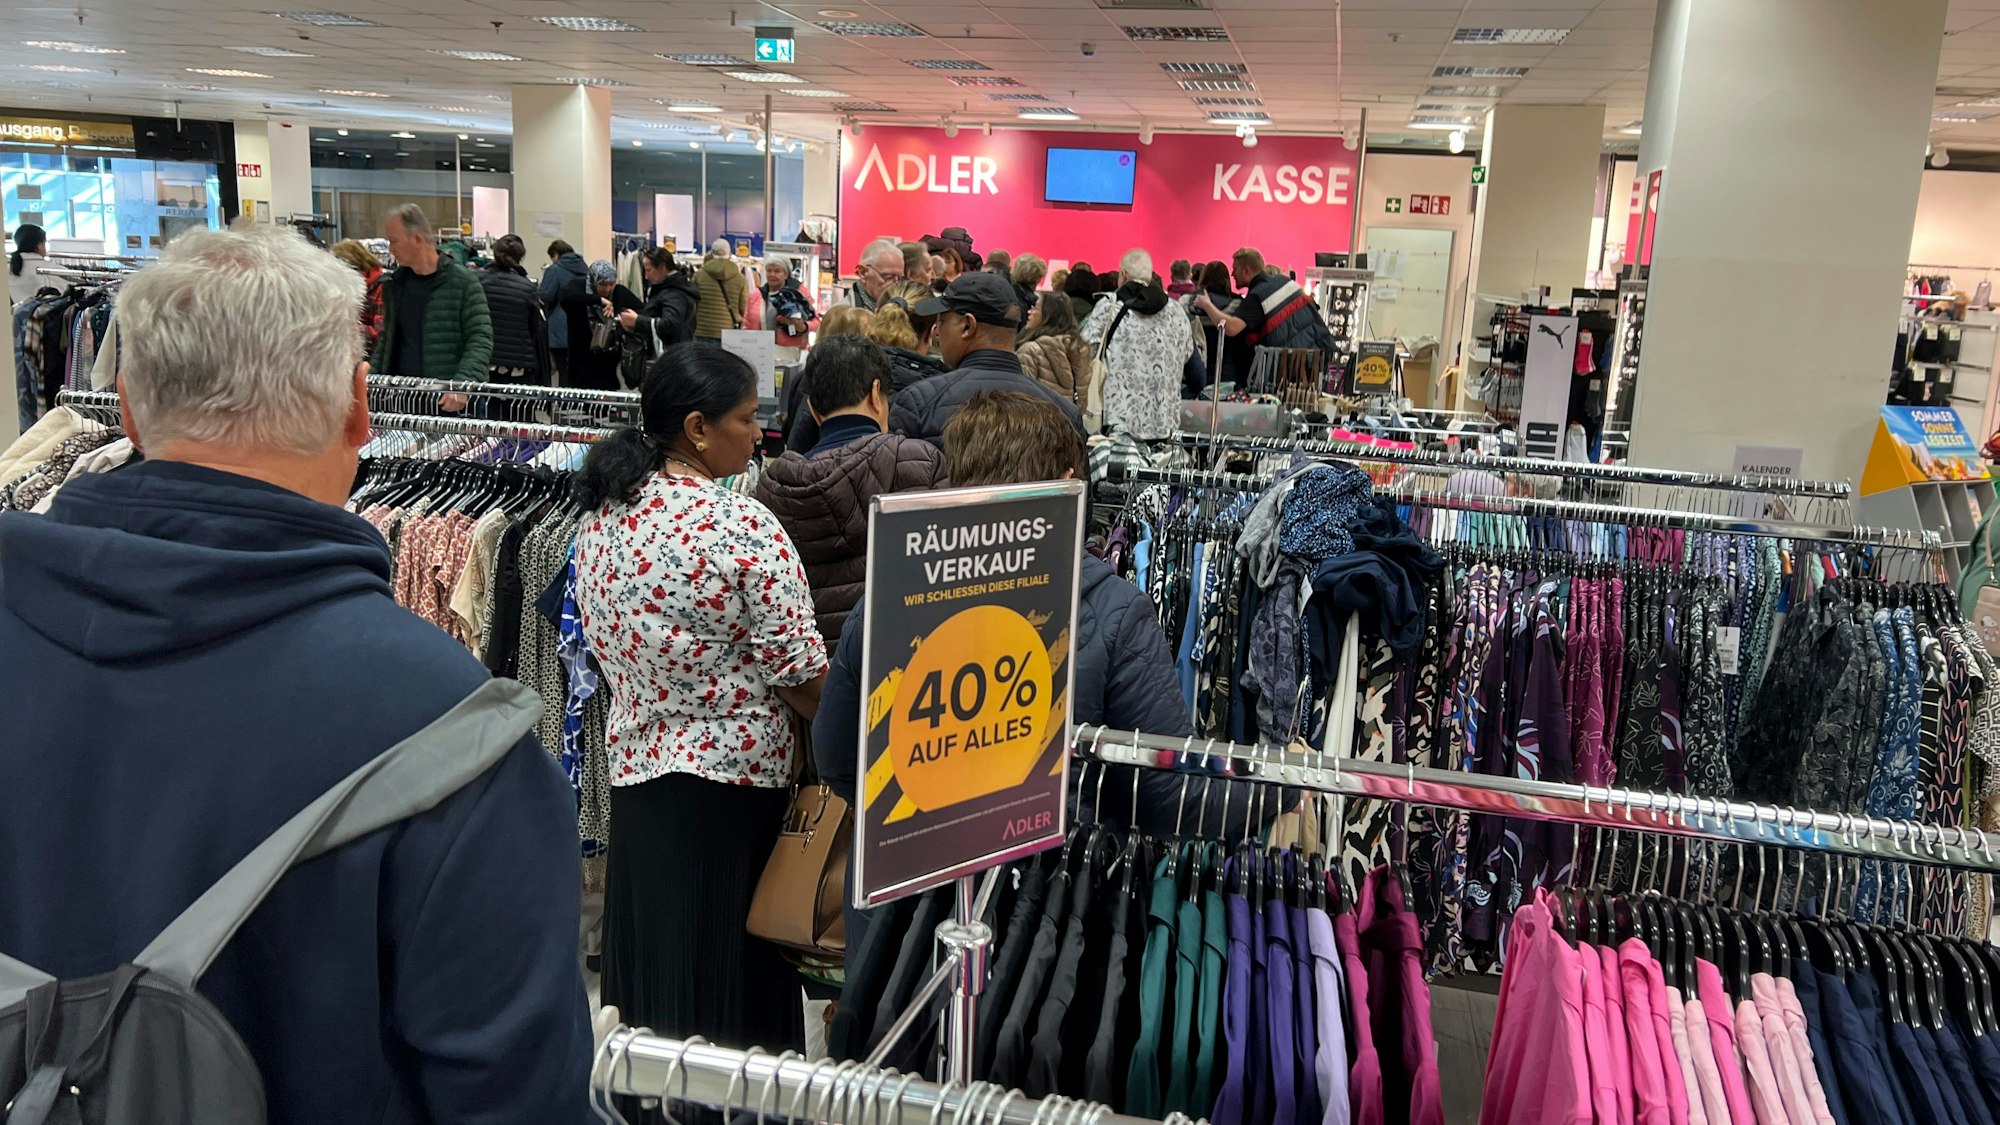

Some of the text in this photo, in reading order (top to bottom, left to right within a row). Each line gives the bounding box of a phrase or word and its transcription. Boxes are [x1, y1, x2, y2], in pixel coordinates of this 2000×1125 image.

[854, 143, 999, 195] ADLER
[1213, 163, 1350, 205] KASSE
[1363, 363, 1387, 374] 40%
[1911, 410, 1956, 422] SOMMER
[1922, 422, 1957, 434] SONNE
[1742, 464, 1792, 475] KALENDER
[905, 516, 1054, 556] RÄUMUNGS-
[924, 547, 1036, 585] VERKAUF
[904, 573, 1050, 607] WIR SCHLIESSEN DIESE FILIALE
[908, 650, 1038, 729] 40%
[908, 715, 1032, 768] AUF ALLES
[1002, 811, 1051, 841] ADLER
